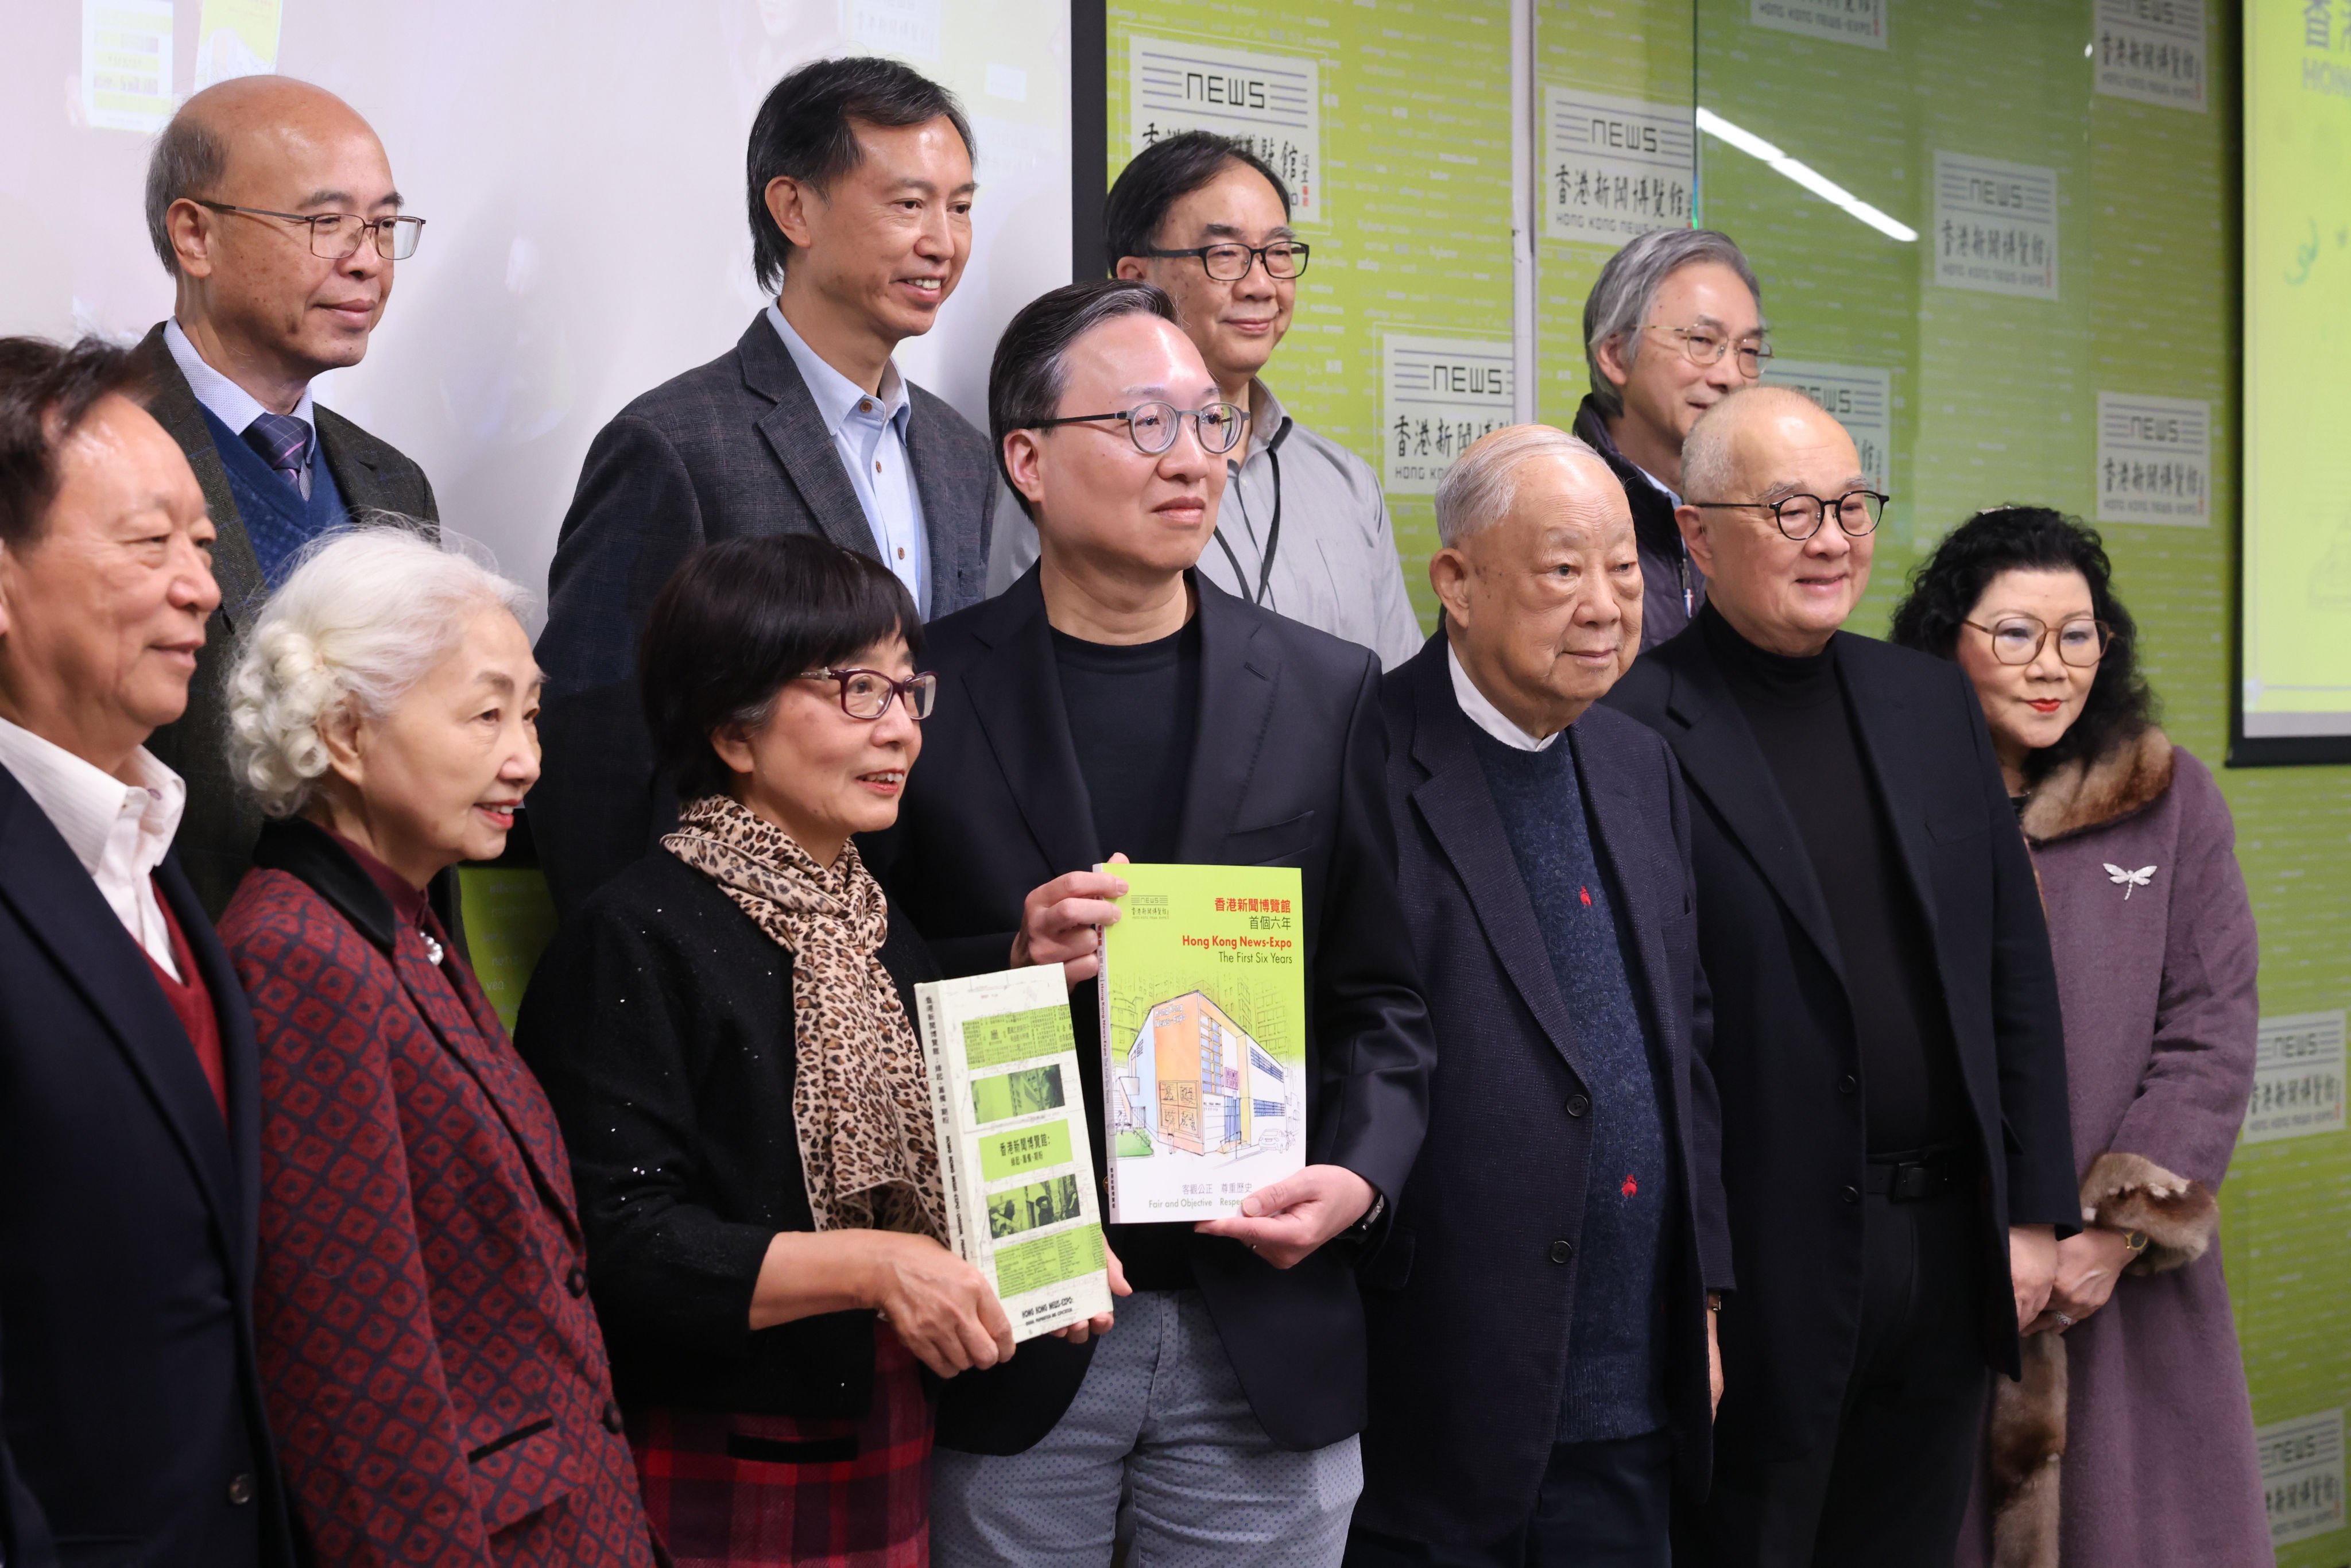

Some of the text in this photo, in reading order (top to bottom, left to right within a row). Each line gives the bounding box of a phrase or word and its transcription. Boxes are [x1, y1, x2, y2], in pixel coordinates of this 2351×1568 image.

[1187, 73, 1265, 109] NEWS
[1592, 119, 1657, 153] NEWS
[1555, 163, 1684, 218] 香港新聞博覽館
[1969, 178, 2023, 209] NEWS
[1434, 365, 1502, 395] NEWS
[1394, 415, 1510, 458] 香港新聞
[2131, 416, 2179, 443] NEWS
[1396, 466, 1425, 480] HONG
[1215, 897, 1291, 913] 香港新聞博覽館
[1249, 916, 1292, 931] 首個六年
[1182, 935, 1292, 951] Hong Kong News-Expo
[1218, 951, 1293, 964] The First Six Years
[2273, 1033, 2317, 1058] NEWS
[1183, 1182, 1252, 1195] 客觀公正 尊重歷史
[1149, 1199, 1163, 1208] Fair
[1165, 1199, 1179, 1208] and
[1180, 1198, 1213, 1209] Objective
